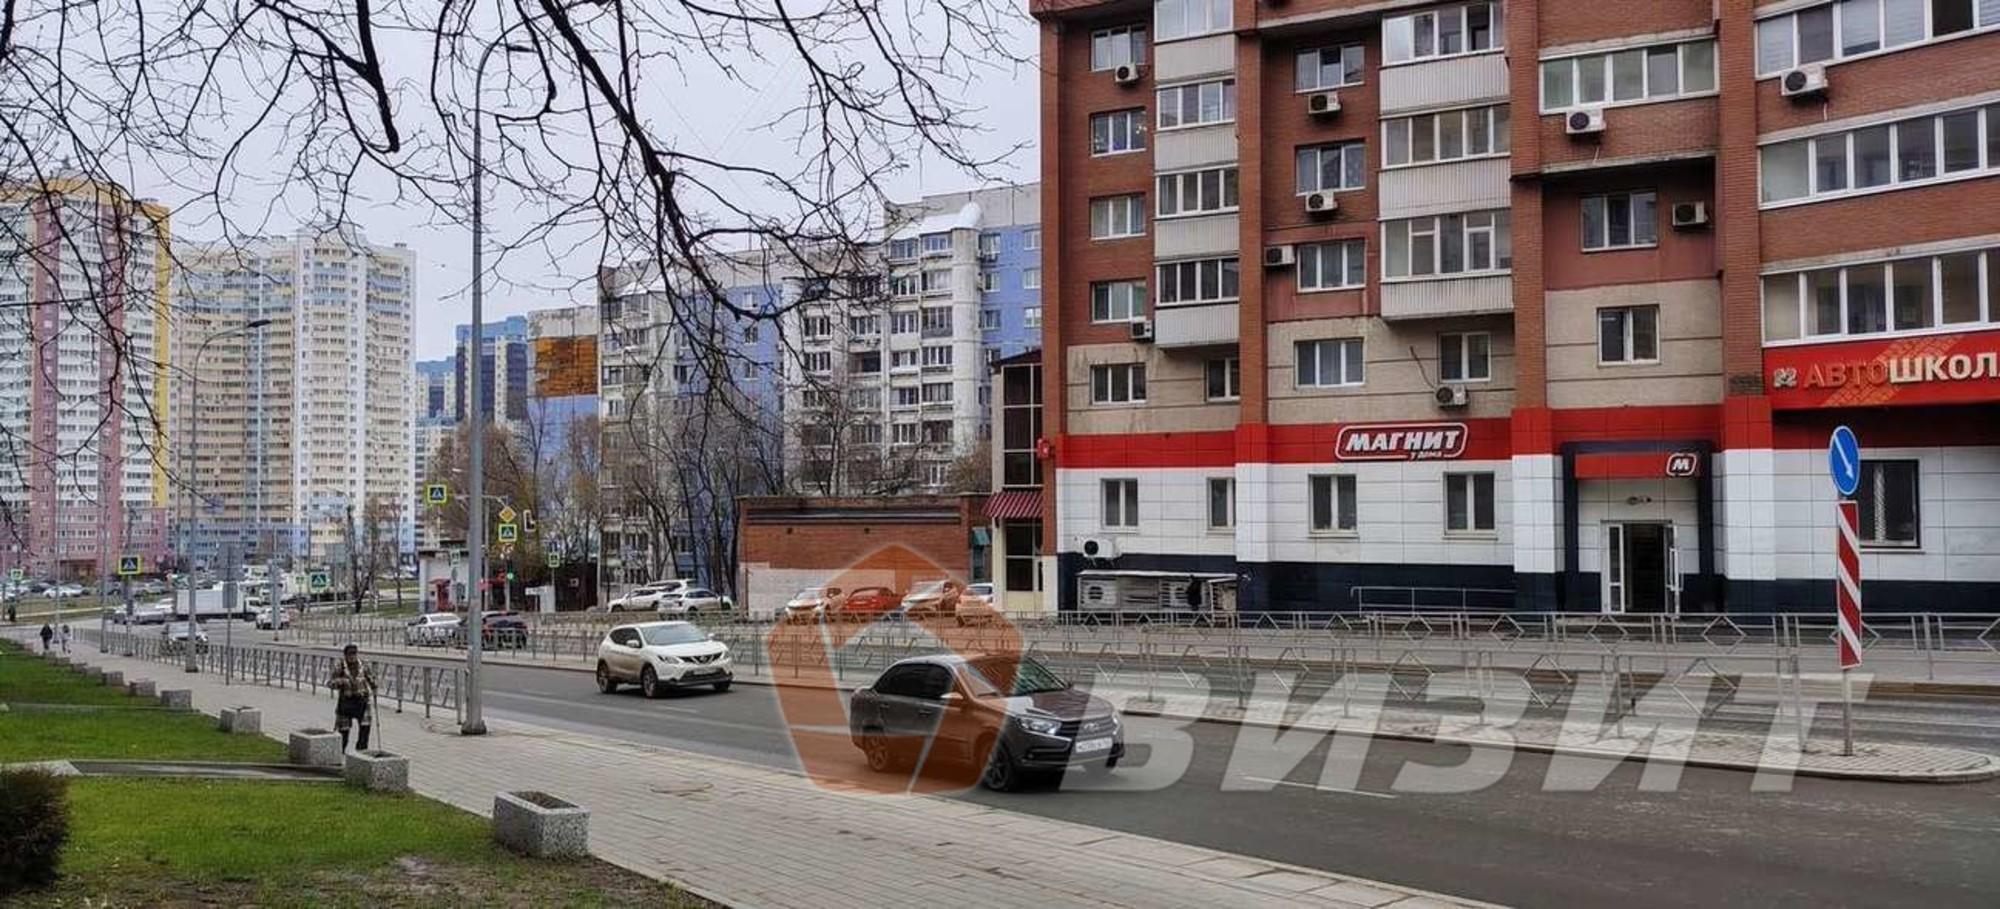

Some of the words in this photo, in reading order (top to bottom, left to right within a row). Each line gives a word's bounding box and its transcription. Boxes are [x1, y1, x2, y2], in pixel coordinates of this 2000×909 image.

[1803, 352, 2000, 388] АВТОШКОЛ
[1345, 430, 1460, 452] МАГНИТ
[1672, 458, 1690, 471] М
